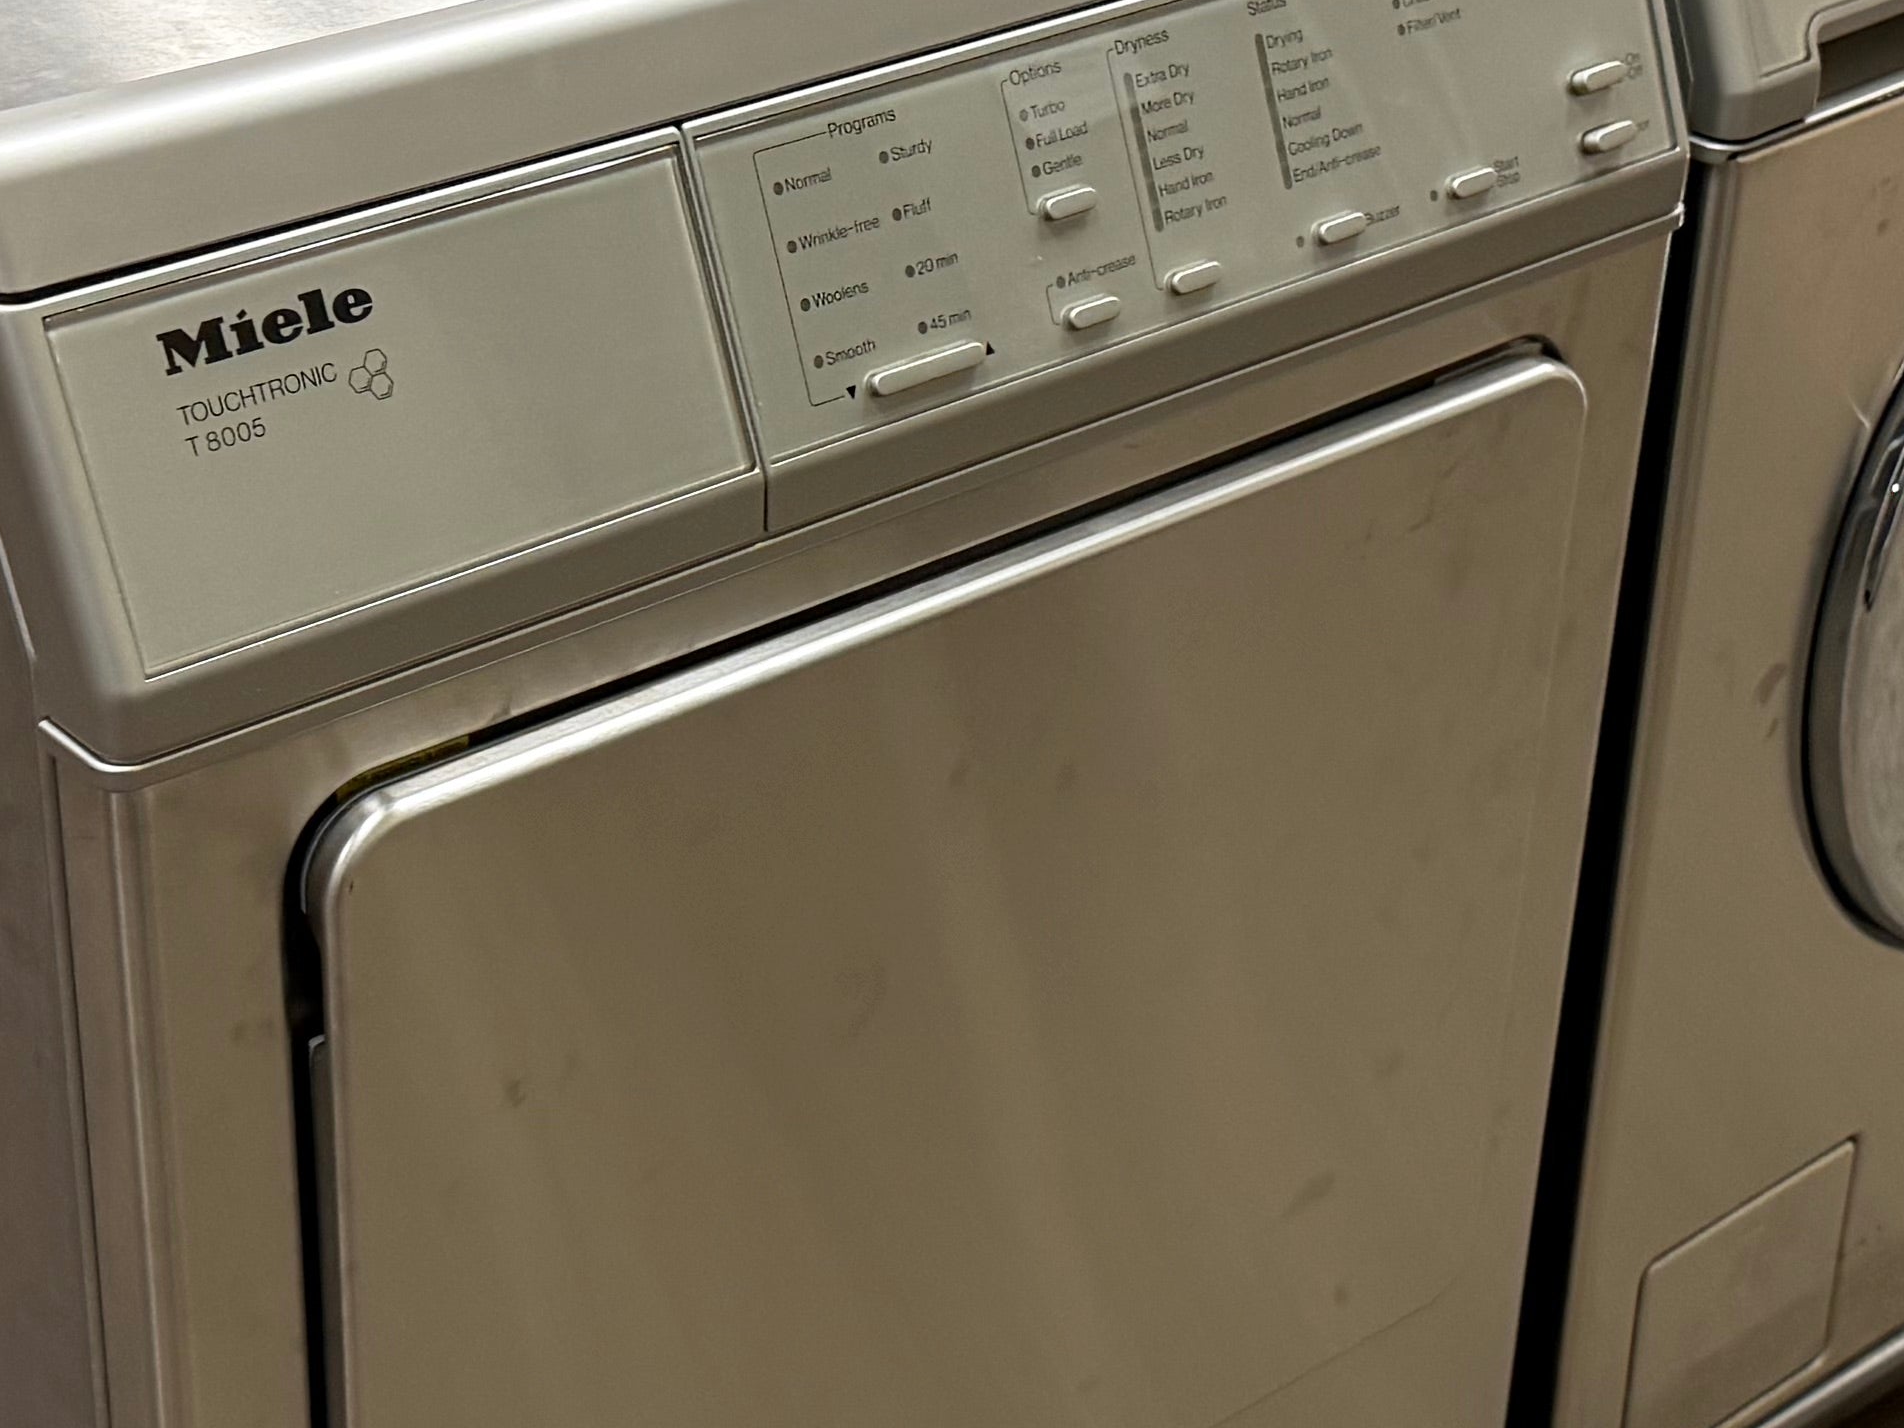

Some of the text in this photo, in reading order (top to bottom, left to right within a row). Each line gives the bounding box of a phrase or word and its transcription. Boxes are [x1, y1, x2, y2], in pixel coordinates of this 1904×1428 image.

[1114, 29, 1170, 55] Dryness
[1266, 29, 1304, 49] Drying
[1010, 61, 1062, 86] Options
[1271, 48, 1333, 74] Rotary Iron
[1135, 63, 1190, 88] Extra Dry
[1141, 90, 1195, 114] More Dry
[1277, 77, 1329, 102] Hand Iron
[1030, 100, 1065, 119] Turbo
[1283, 105, 1321, 129] Normal
[827, 108, 896, 138] Programs
[1036, 121, 1088, 148] Full Load
[1148, 119, 1188, 142] Normal
[889, 139, 932, 162] Sturdy
[1288, 123, 1363, 156] Cooling Down
[1042, 153, 1082, 175] Gentle
[1153, 145, 1204, 170] Less Dry
[784, 167, 832, 192] Normal
[1159, 170, 1214, 197] Hand Iron
[903, 197, 931, 220] Fluff
[1165, 194, 1227, 224] Rotary Iron
[798, 216, 880, 250] Wrinkle-free
[915, 252, 958, 275] 20 min
[1068, 254, 1136, 286] Anti-crease
[811, 281, 869, 308] Woolens
[156, 288, 373, 376] Miele
[929, 309, 971, 330] 45 min
[826, 339, 876, 366] Smooth
[176, 362, 337, 426] TOUCHTRONIC
[184, 417, 266, 457] T 8005
